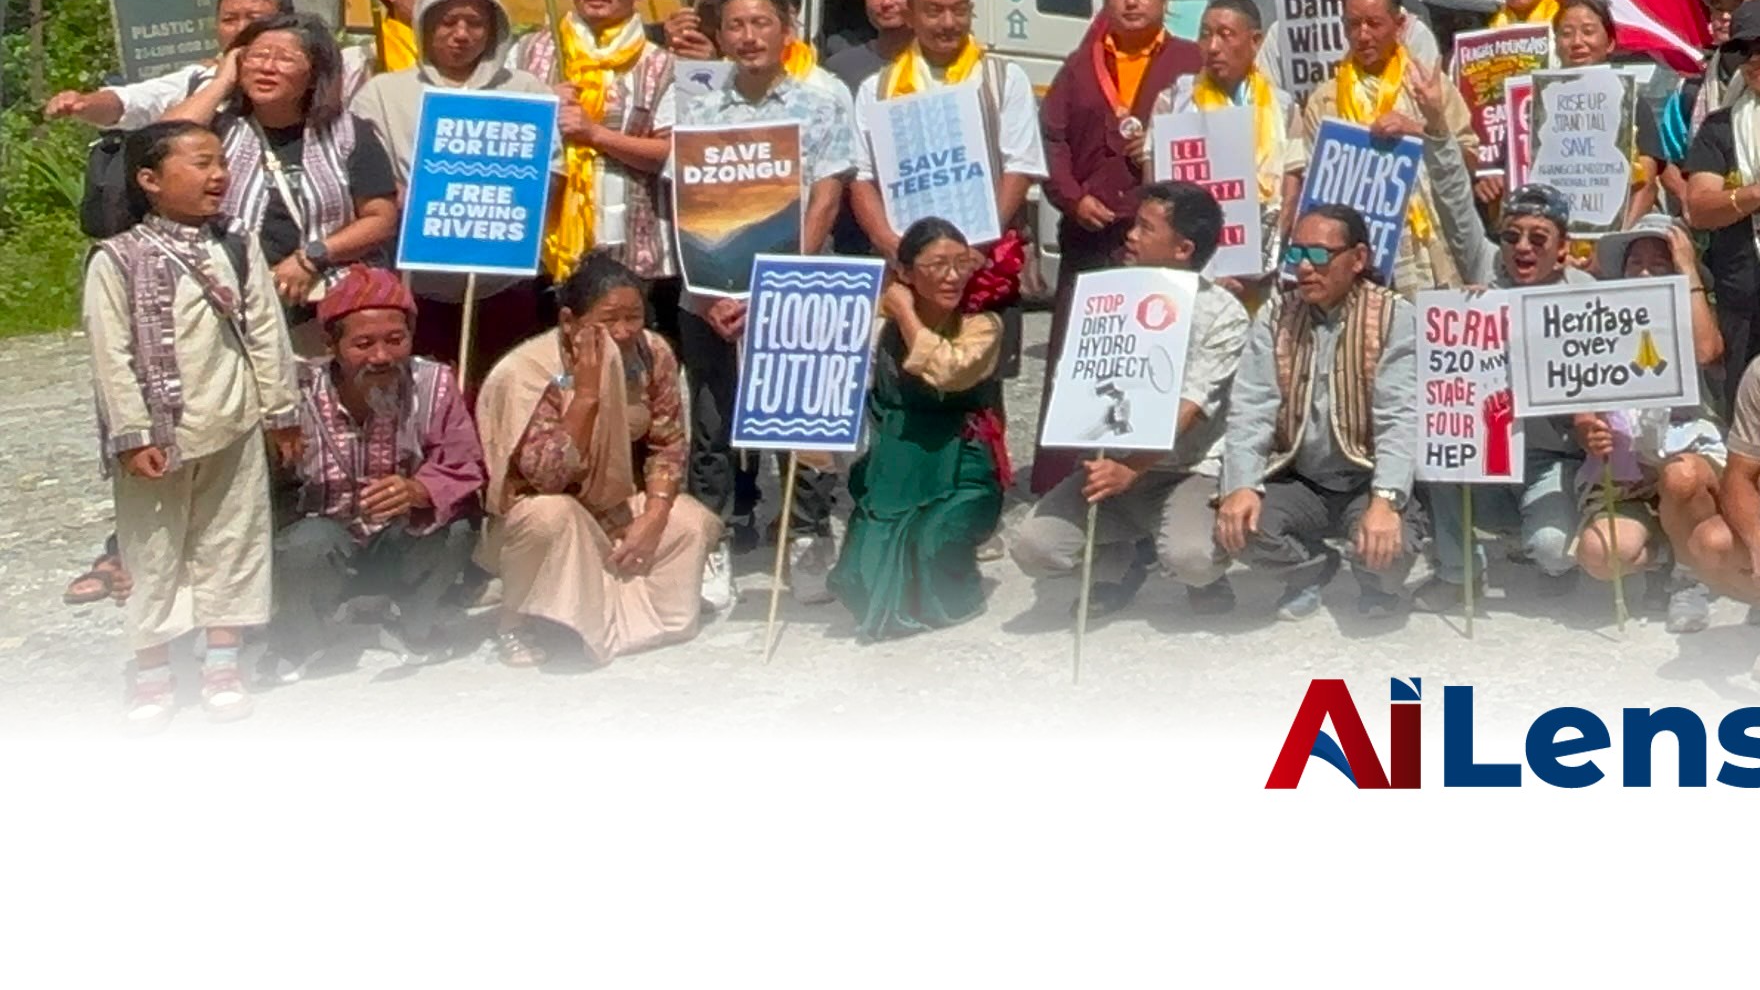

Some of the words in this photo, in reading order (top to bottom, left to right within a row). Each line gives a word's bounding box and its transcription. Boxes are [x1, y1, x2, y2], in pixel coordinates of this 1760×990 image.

[131, 19, 194, 40] PLASTIC
[1288, 22, 1343, 54] Will
[1557, 94, 1585, 111] RISE
[437, 117, 537, 142] RIVERS
[1552, 114, 1585, 133] STAND
[1586, 113, 1608, 132] TALL
[433, 137, 482, 155] FOR
[487, 141, 535, 158] LIFE
[704, 142, 771, 164] SAVE
[1173, 141, 1204, 160] LET
[1560, 136, 1596, 157] SAVE
[683, 160, 792, 184] DZONGU
[899, 145, 967, 177] SAVE
[1173, 163, 1208, 181] OUR
[888, 161, 985, 199] TEESTA
[446, 182, 513, 204] FREE
[426, 201, 527, 221] FLOWING
[422, 217, 525, 241] RIVERS
[1084, 293, 1125, 315] STOP
[754, 290, 871, 353] FLOODED
[1081, 314, 1128, 336] DIRTY
[1543, 296, 1650, 338] Heritage
[1077, 334, 1137, 358] HYDRO
[1562, 336, 1619, 357] over
[1072, 357, 1150, 380] PROJECT
[1429, 350, 1474, 374] 520
[1480, 352, 1509, 372] MW
[746, 352, 863, 417] FUTURE
[1547, 360, 1630, 397] Hydro
[1426, 376, 1476, 407] STAGE
[1426, 412, 1474, 438] FOUR
[1426, 442, 1477, 468] HEP
